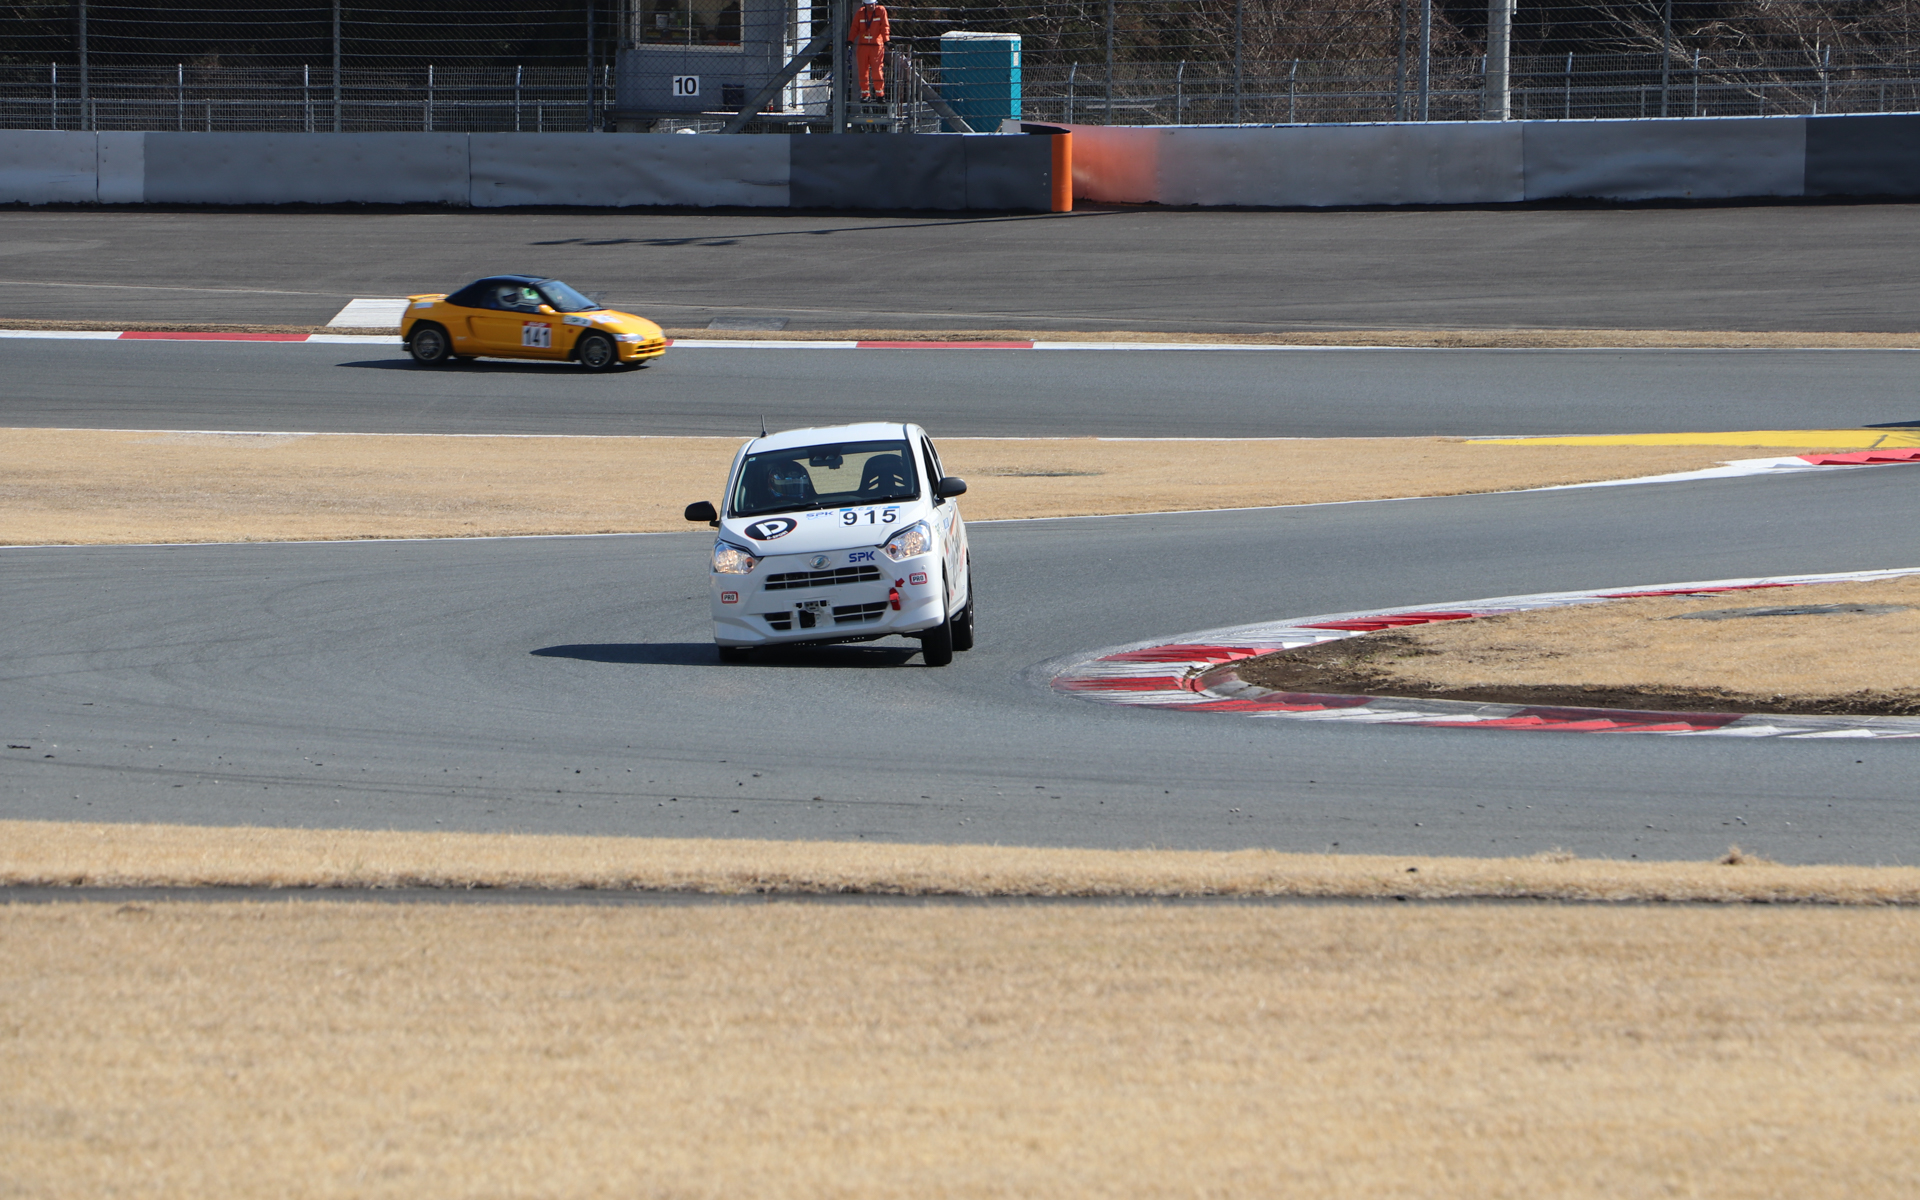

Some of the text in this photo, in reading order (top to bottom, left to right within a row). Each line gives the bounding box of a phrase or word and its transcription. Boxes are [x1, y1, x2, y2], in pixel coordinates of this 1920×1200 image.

[675, 77, 697, 95] 10
[524, 327, 549, 347] 141
[843, 509, 897, 526] 915
[849, 551, 875, 563] SPK
